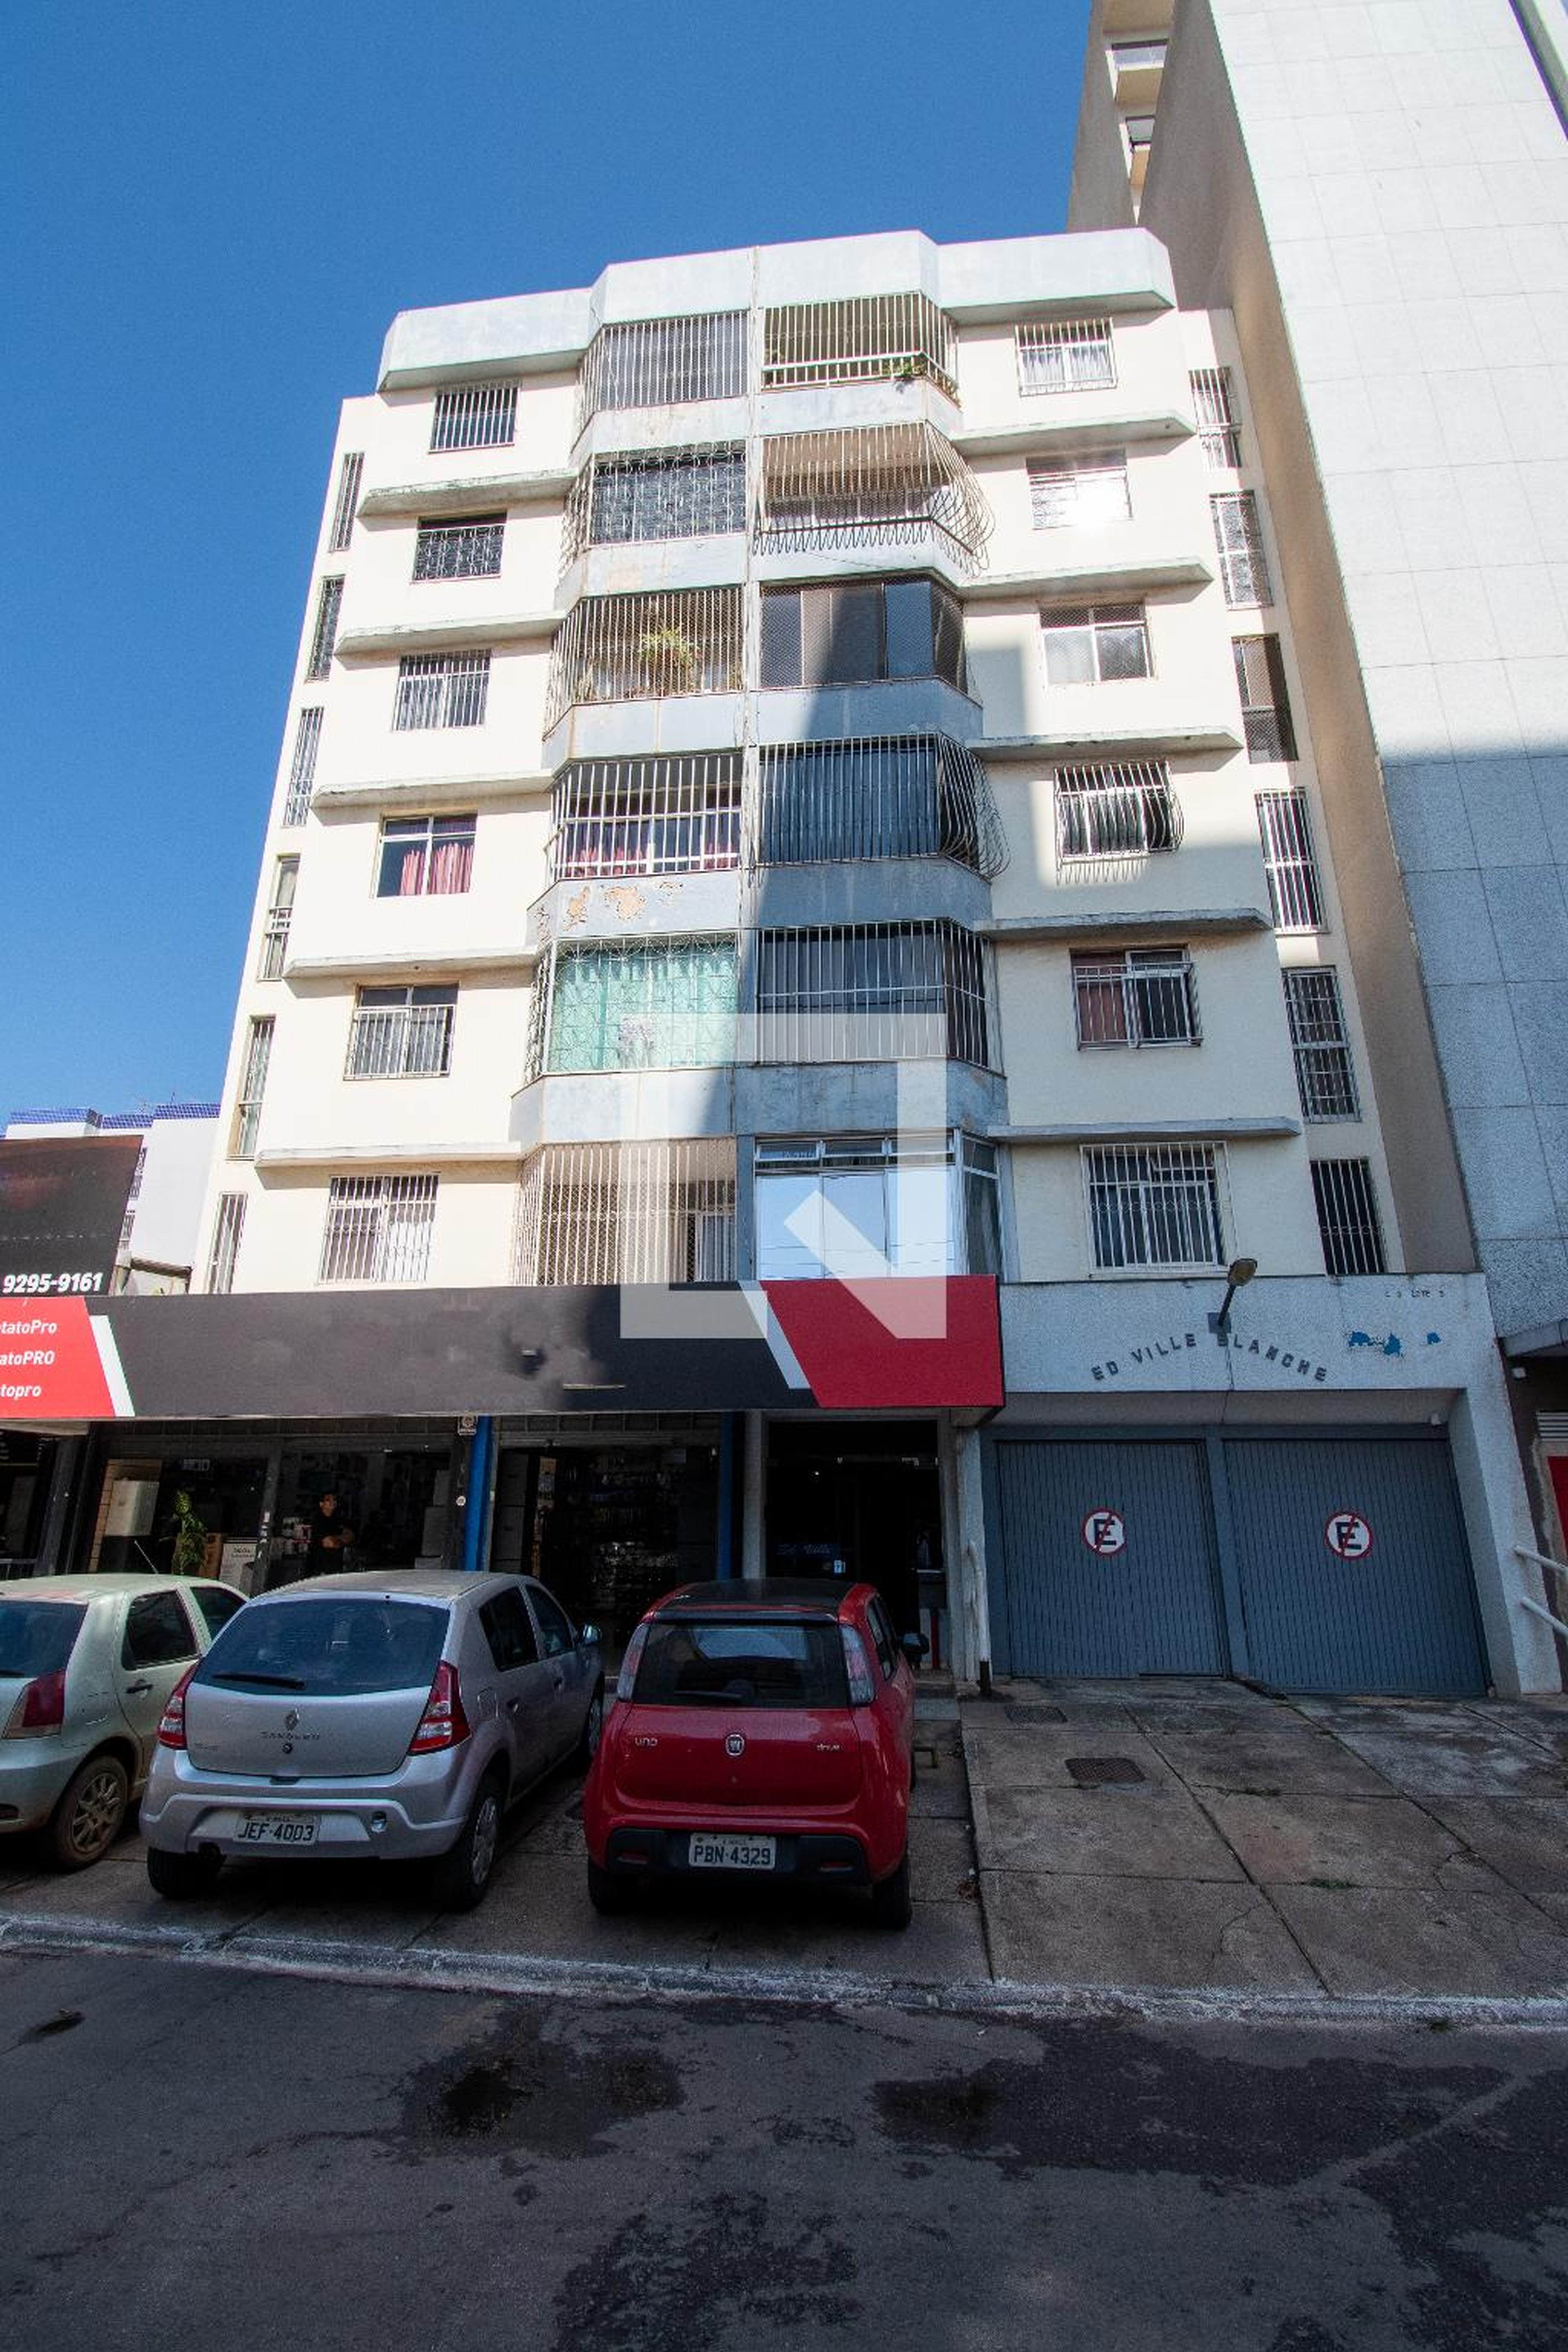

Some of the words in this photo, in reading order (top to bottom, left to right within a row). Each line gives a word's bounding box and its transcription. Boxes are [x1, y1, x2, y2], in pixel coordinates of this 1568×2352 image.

[3, 1272, 103, 1293] 9295-9161
[0, 1319, 57, 1334] tatoPro
[1091, 1361, 1119, 1381] ED
[1131, 1334, 1196, 1363] VILLE
